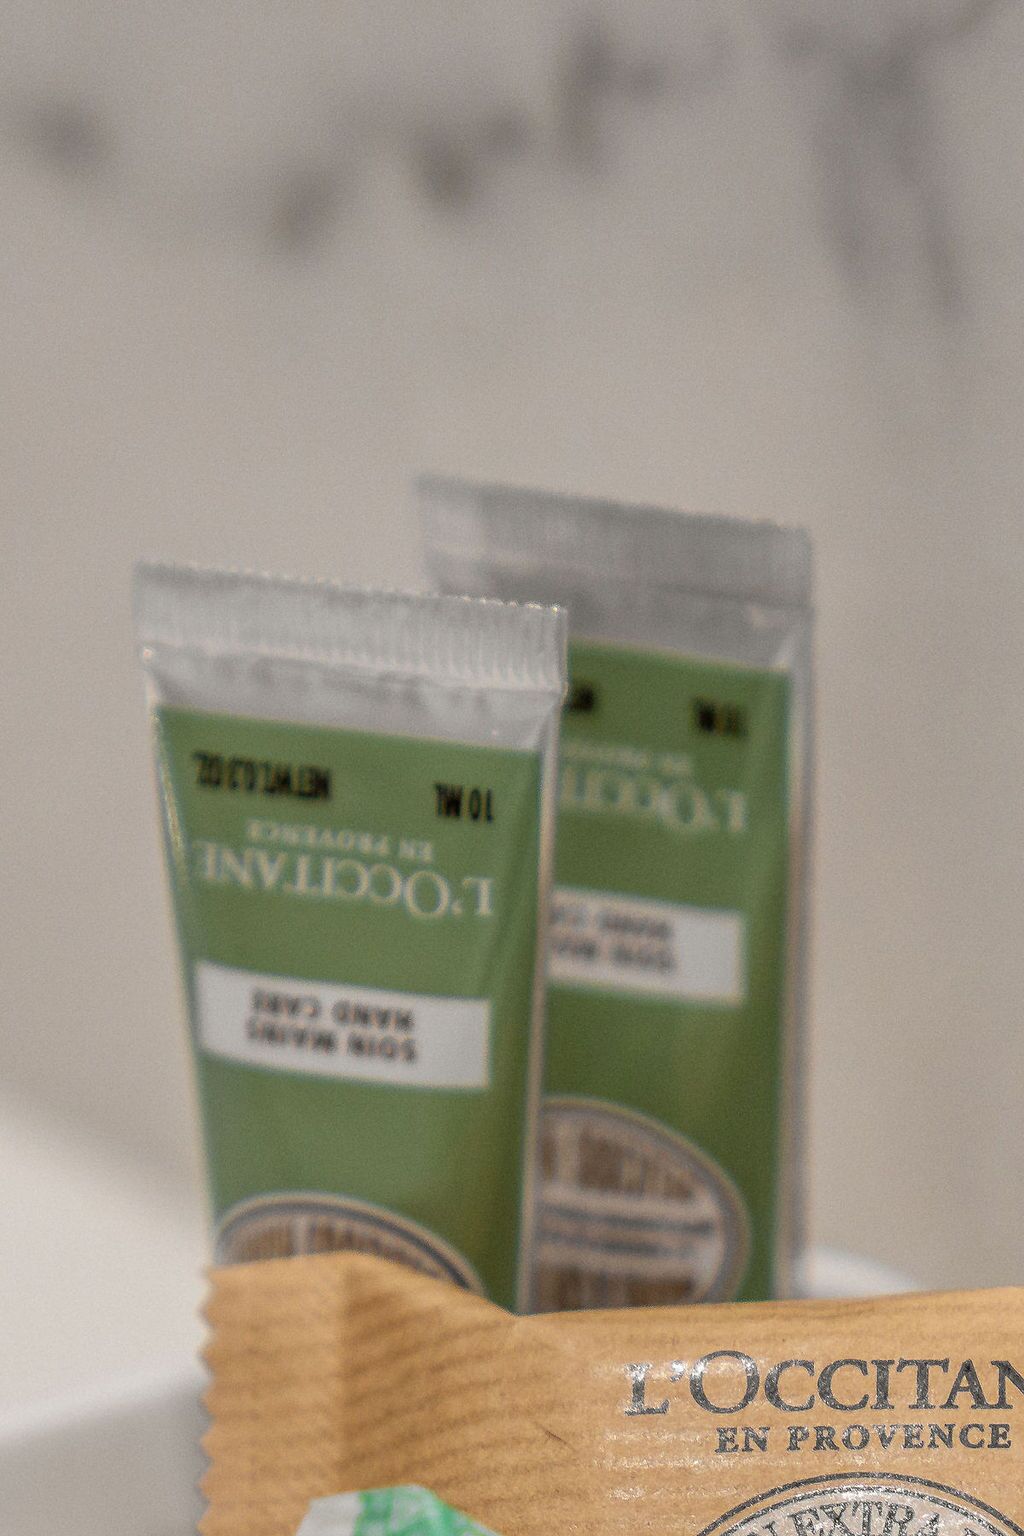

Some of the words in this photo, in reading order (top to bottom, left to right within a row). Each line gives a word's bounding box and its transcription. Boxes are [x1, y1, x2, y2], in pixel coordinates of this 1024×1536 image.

[247, 817, 390, 858] PROVENCE
[400, 837, 434, 865] EN
[192, 842, 496, 920] L'OCCITANE
[252, 989, 321, 1019] CARE
[332, 998, 416, 1032] HAND
[245, 1016, 338, 1054] MAINS
[348, 1032, 418, 1065] SOIN
[714, 1425, 772, 1454] EN
[786, 1421, 1013, 1452] PROVENCE
